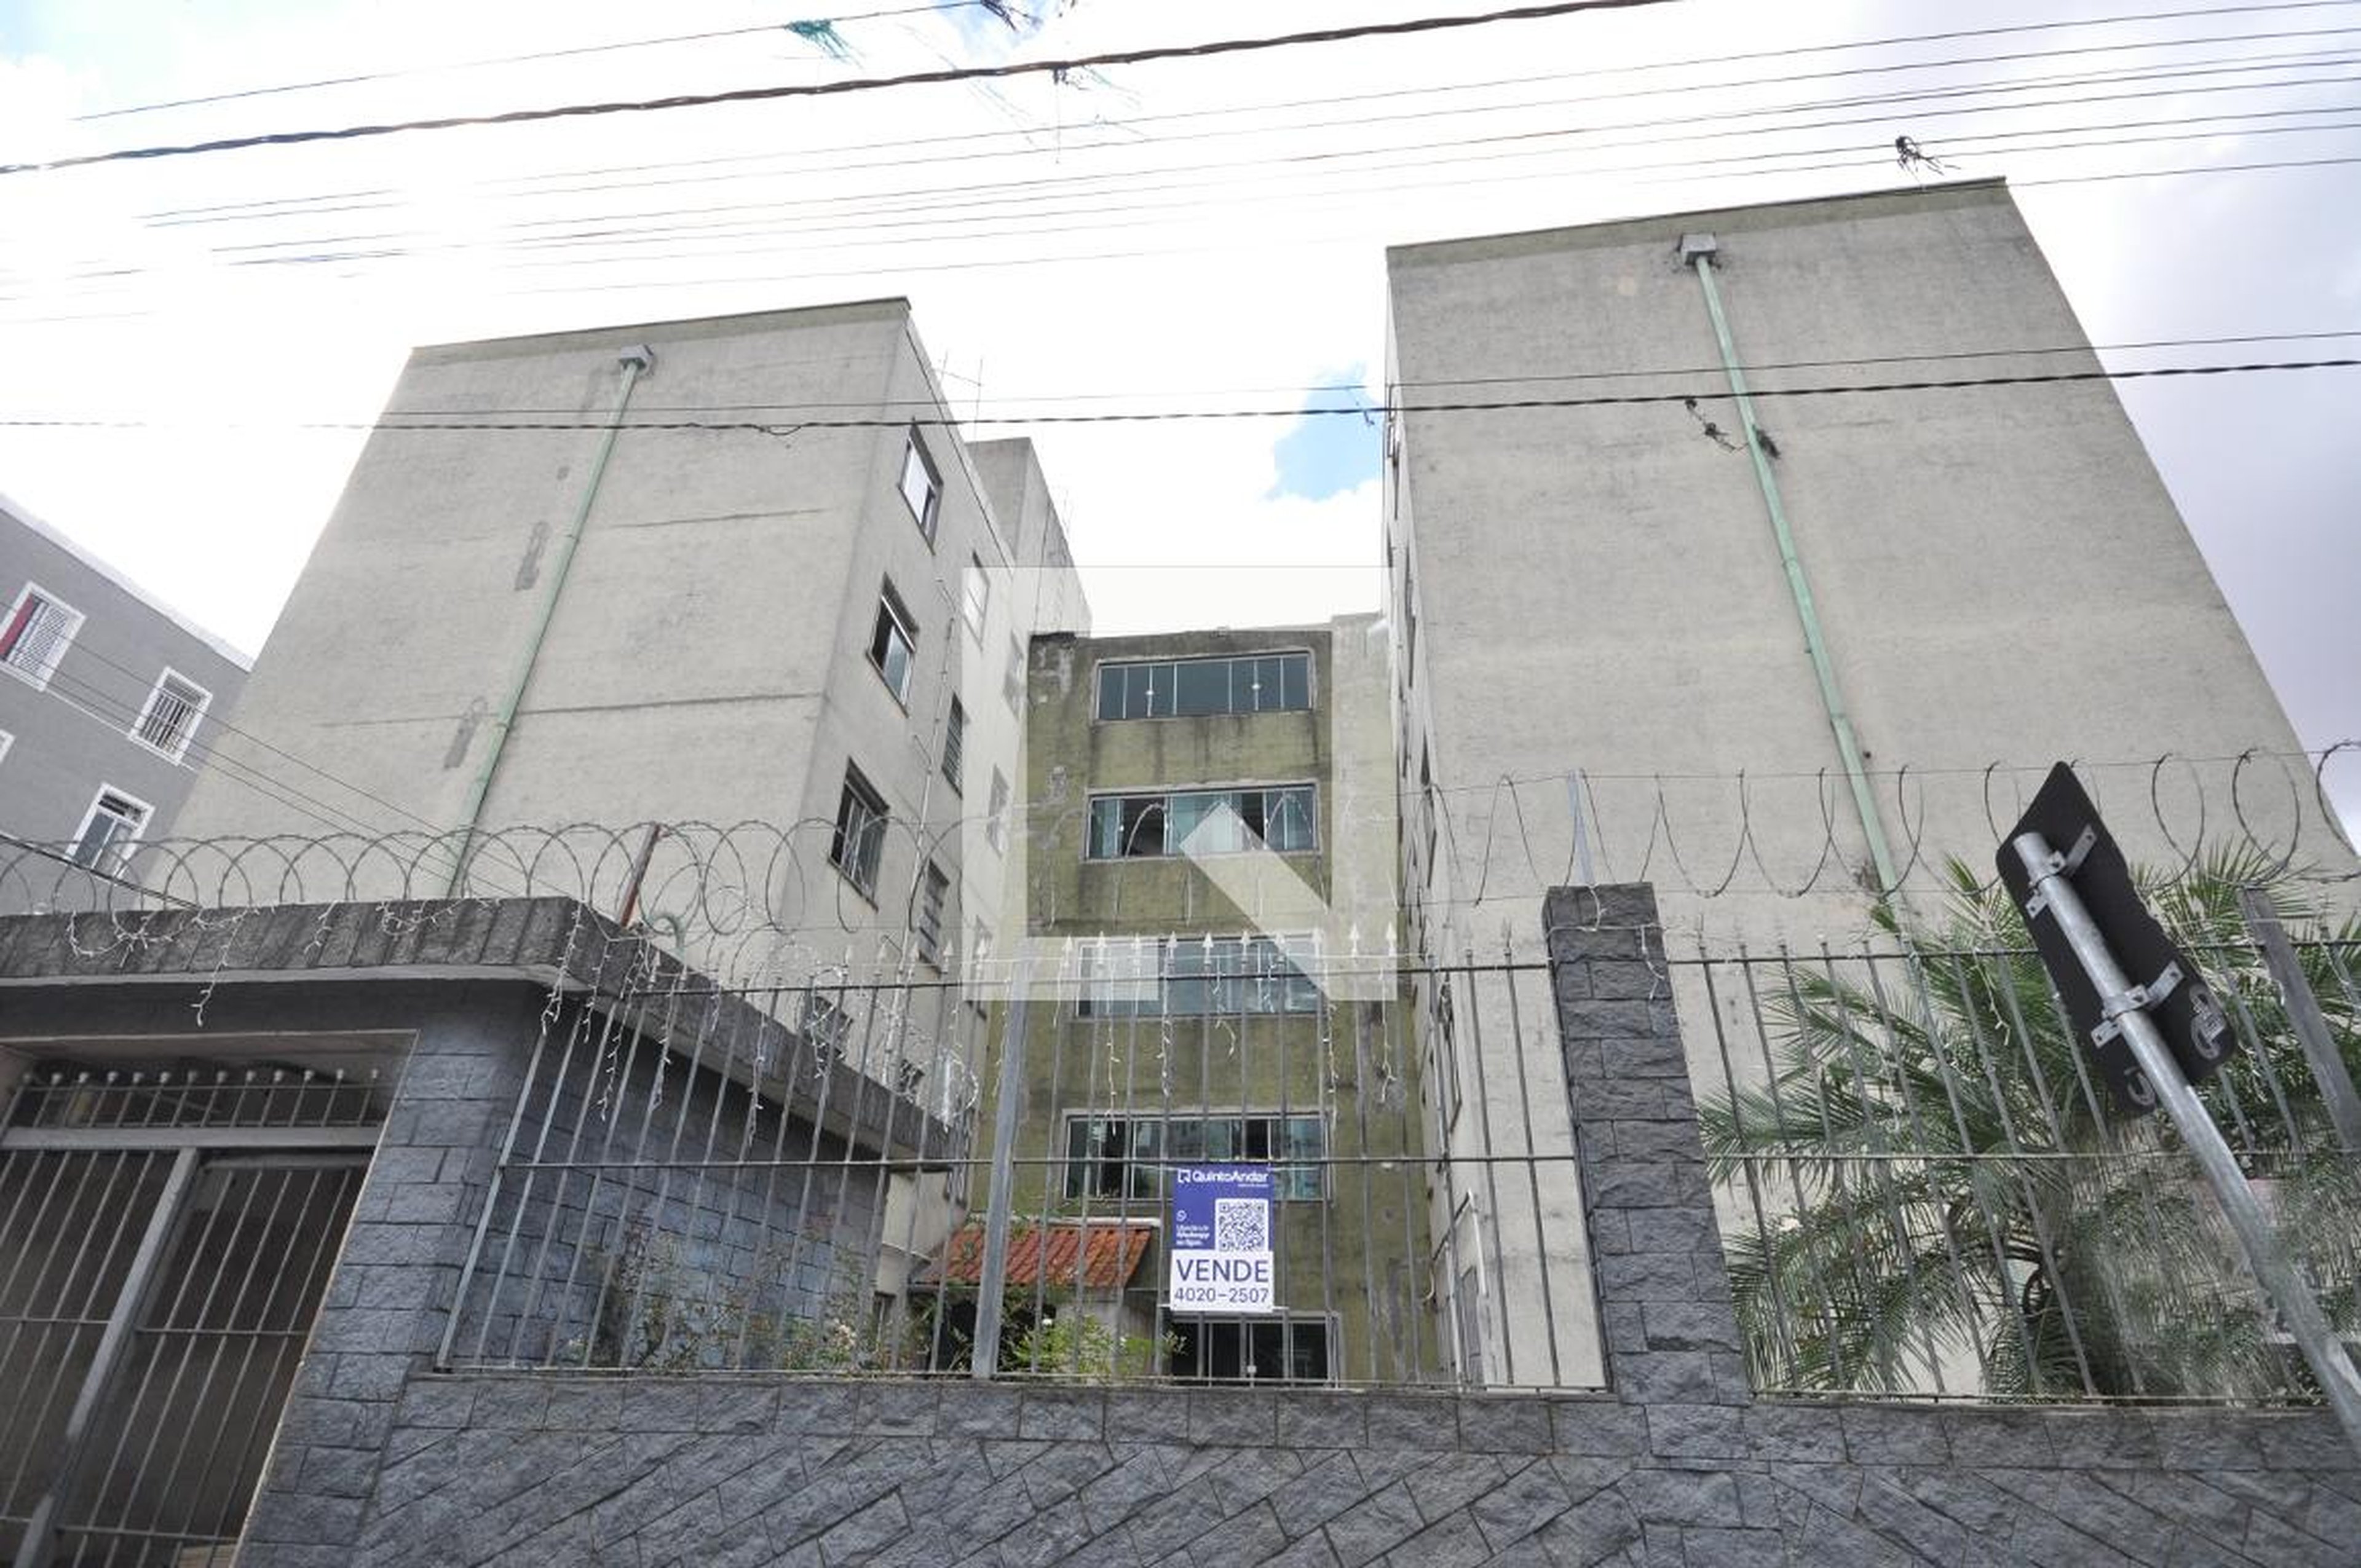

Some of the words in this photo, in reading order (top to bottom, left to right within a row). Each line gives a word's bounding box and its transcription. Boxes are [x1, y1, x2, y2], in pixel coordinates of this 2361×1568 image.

[1192, 1170, 1268, 1182] QuintoAndar
[1176, 1259, 1268, 1282] VENDE
[1174, 1288, 1268, 1303] 4020-2507
